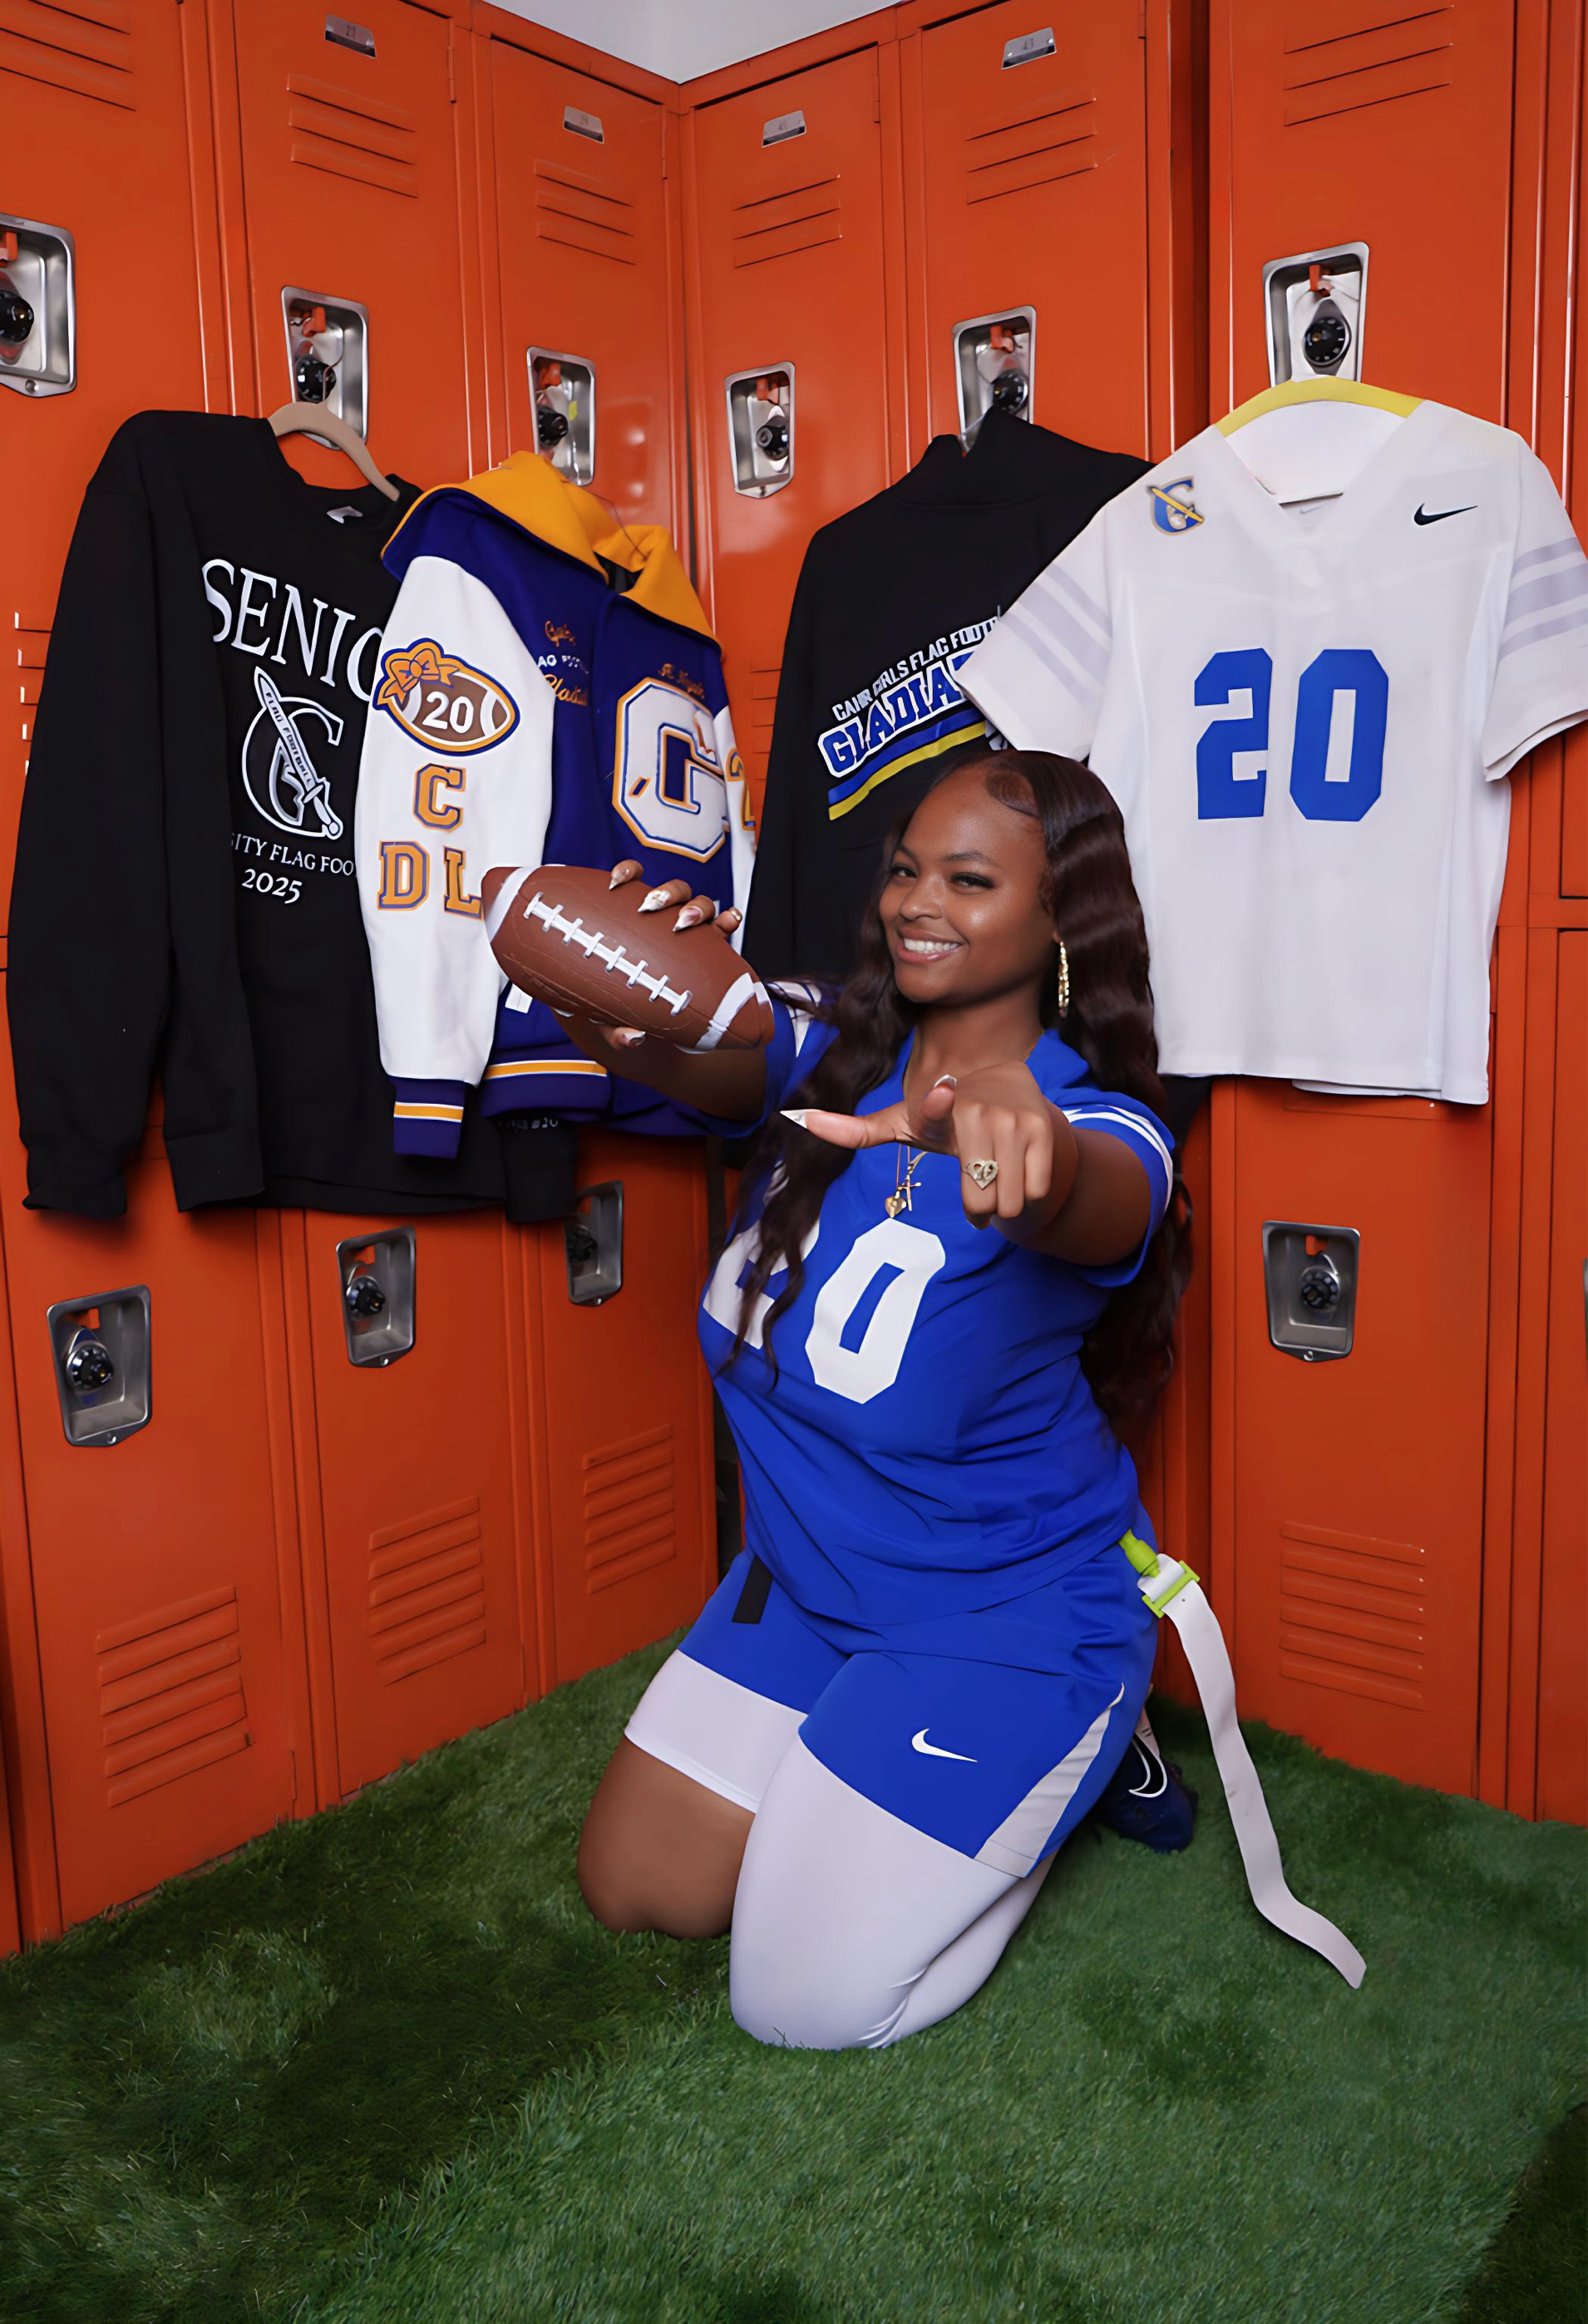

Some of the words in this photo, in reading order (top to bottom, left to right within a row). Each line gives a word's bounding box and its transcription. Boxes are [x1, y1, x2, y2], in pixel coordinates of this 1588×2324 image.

[422, 691, 474, 734] 20
[1194, 648, 1389, 822] 20
[413, 762, 466, 832] C
[269, 844, 316, 870] FLAG
[242, 869, 303, 904] 2025
[703, 1217, 946, 1405] 20
